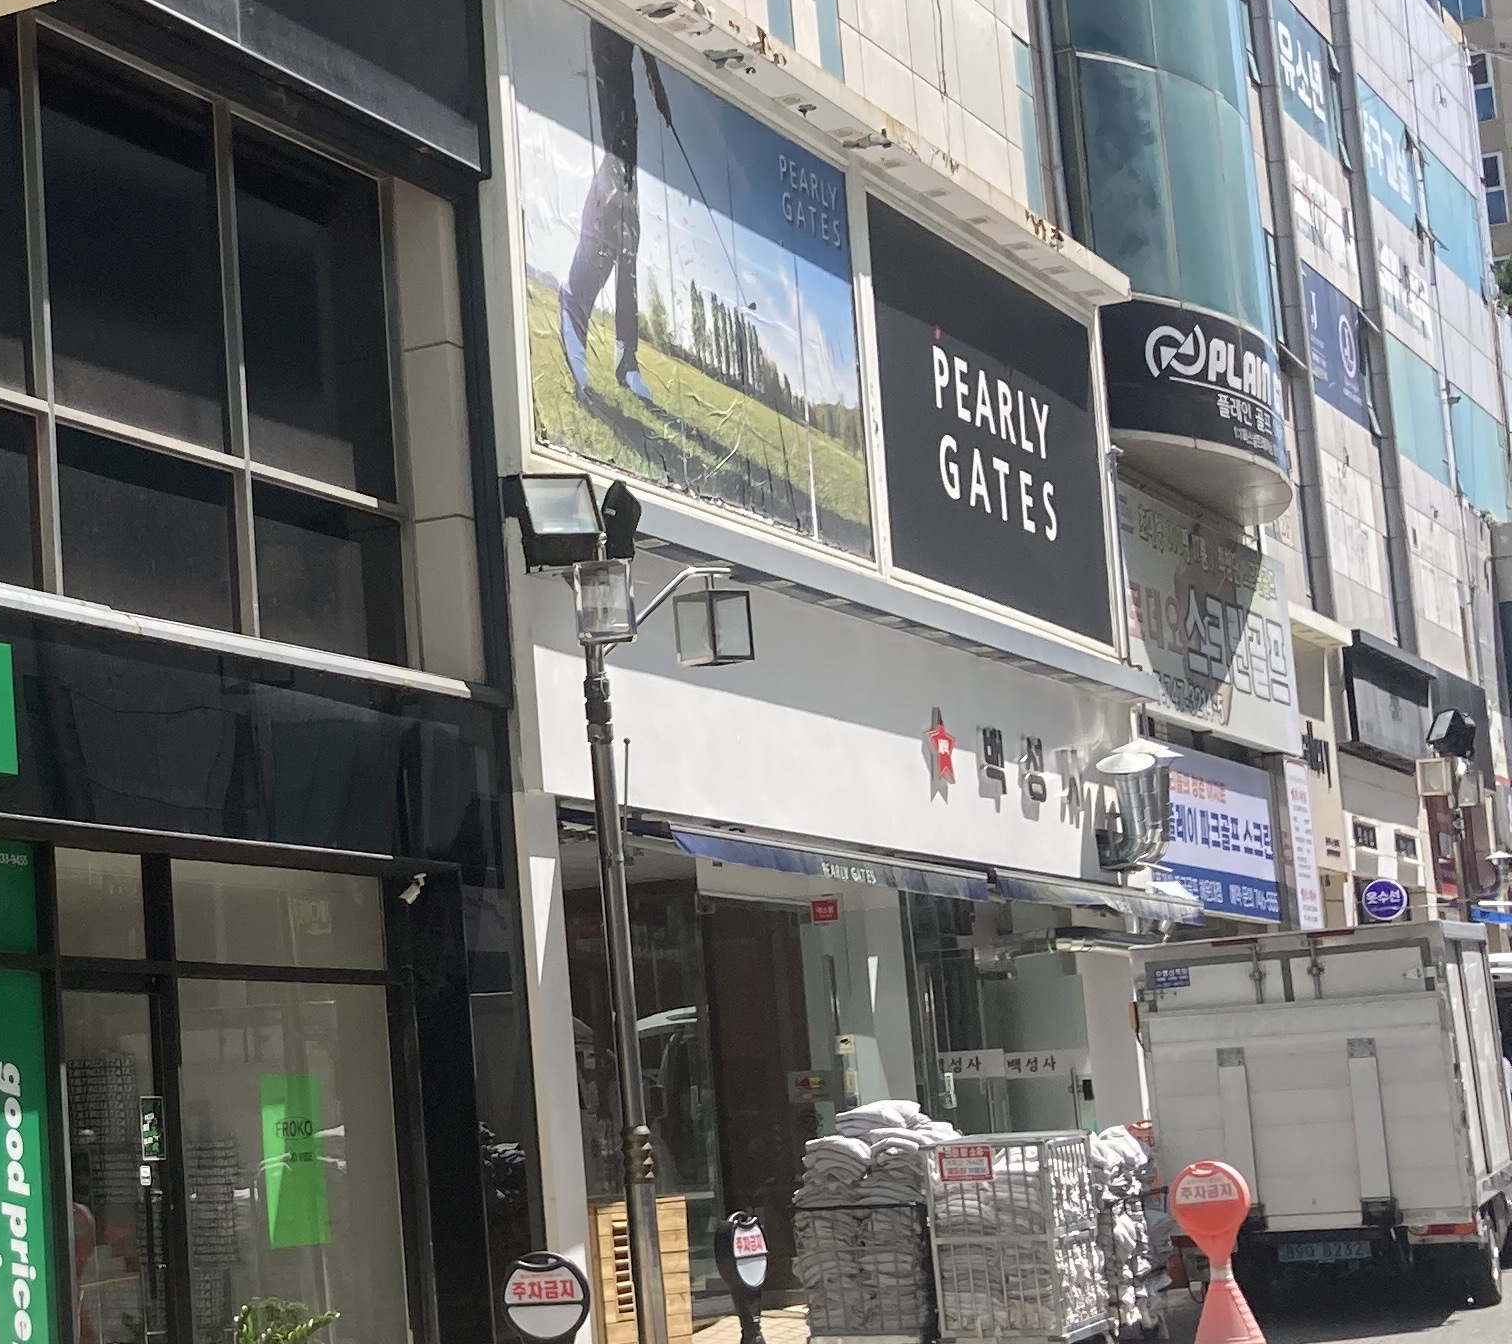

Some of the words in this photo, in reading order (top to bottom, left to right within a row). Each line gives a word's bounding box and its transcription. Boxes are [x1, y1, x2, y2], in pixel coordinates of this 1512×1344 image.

[1277, 21, 1326, 123] 유소년
[779, 155, 838, 212] PEARLY
[781, 192, 842, 248] GATES
[1207, 337, 1272, 406] PLAIN
[932, 344, 1049, 460] PEARLY
[1217, 393, 1252, 426] 플레인
[1255, 406, 1273, 435] 골프
[939, 434, 1059, 542] GATES
[1183, 585, 1291, 707] 스크린골프
[1199, 809, 1241, 852] 파크골프
[1365, 889, 1401, 905] 옷수선
[1006, 1056, 1057, 1073] 백성사
[1180, 1183, 1233, 1200] 주차금지
[736, 1234, 763, 1254] 주차금지
[512, 1279, 575, 1301] 주차금지
